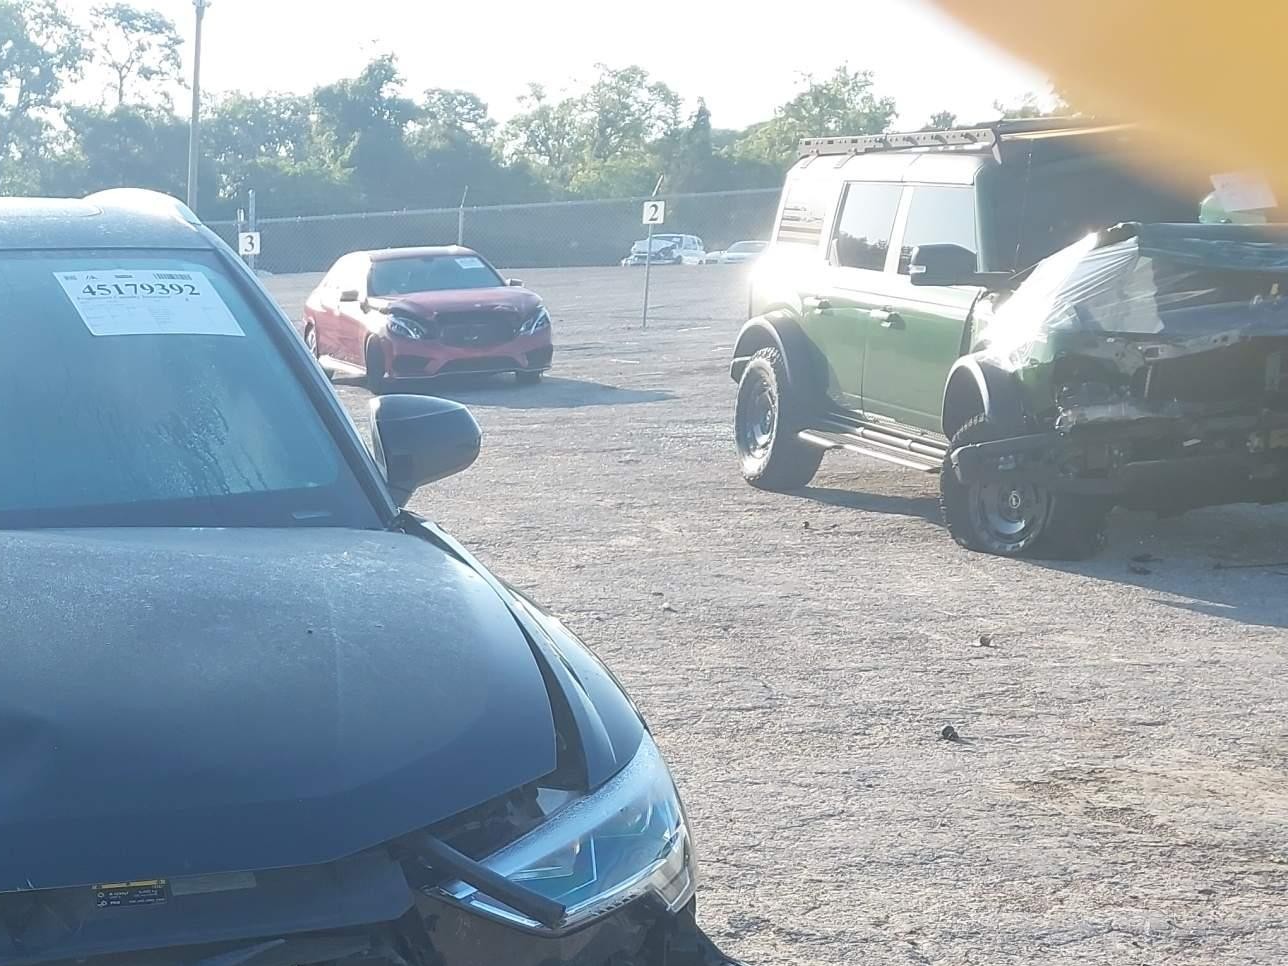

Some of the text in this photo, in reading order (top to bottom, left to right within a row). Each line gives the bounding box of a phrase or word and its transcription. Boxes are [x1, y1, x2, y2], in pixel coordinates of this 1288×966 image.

[648, 203, 659, 221] 2
[244, 234, 255, 252] 3
[82, 283, 201, 297] 45179392
